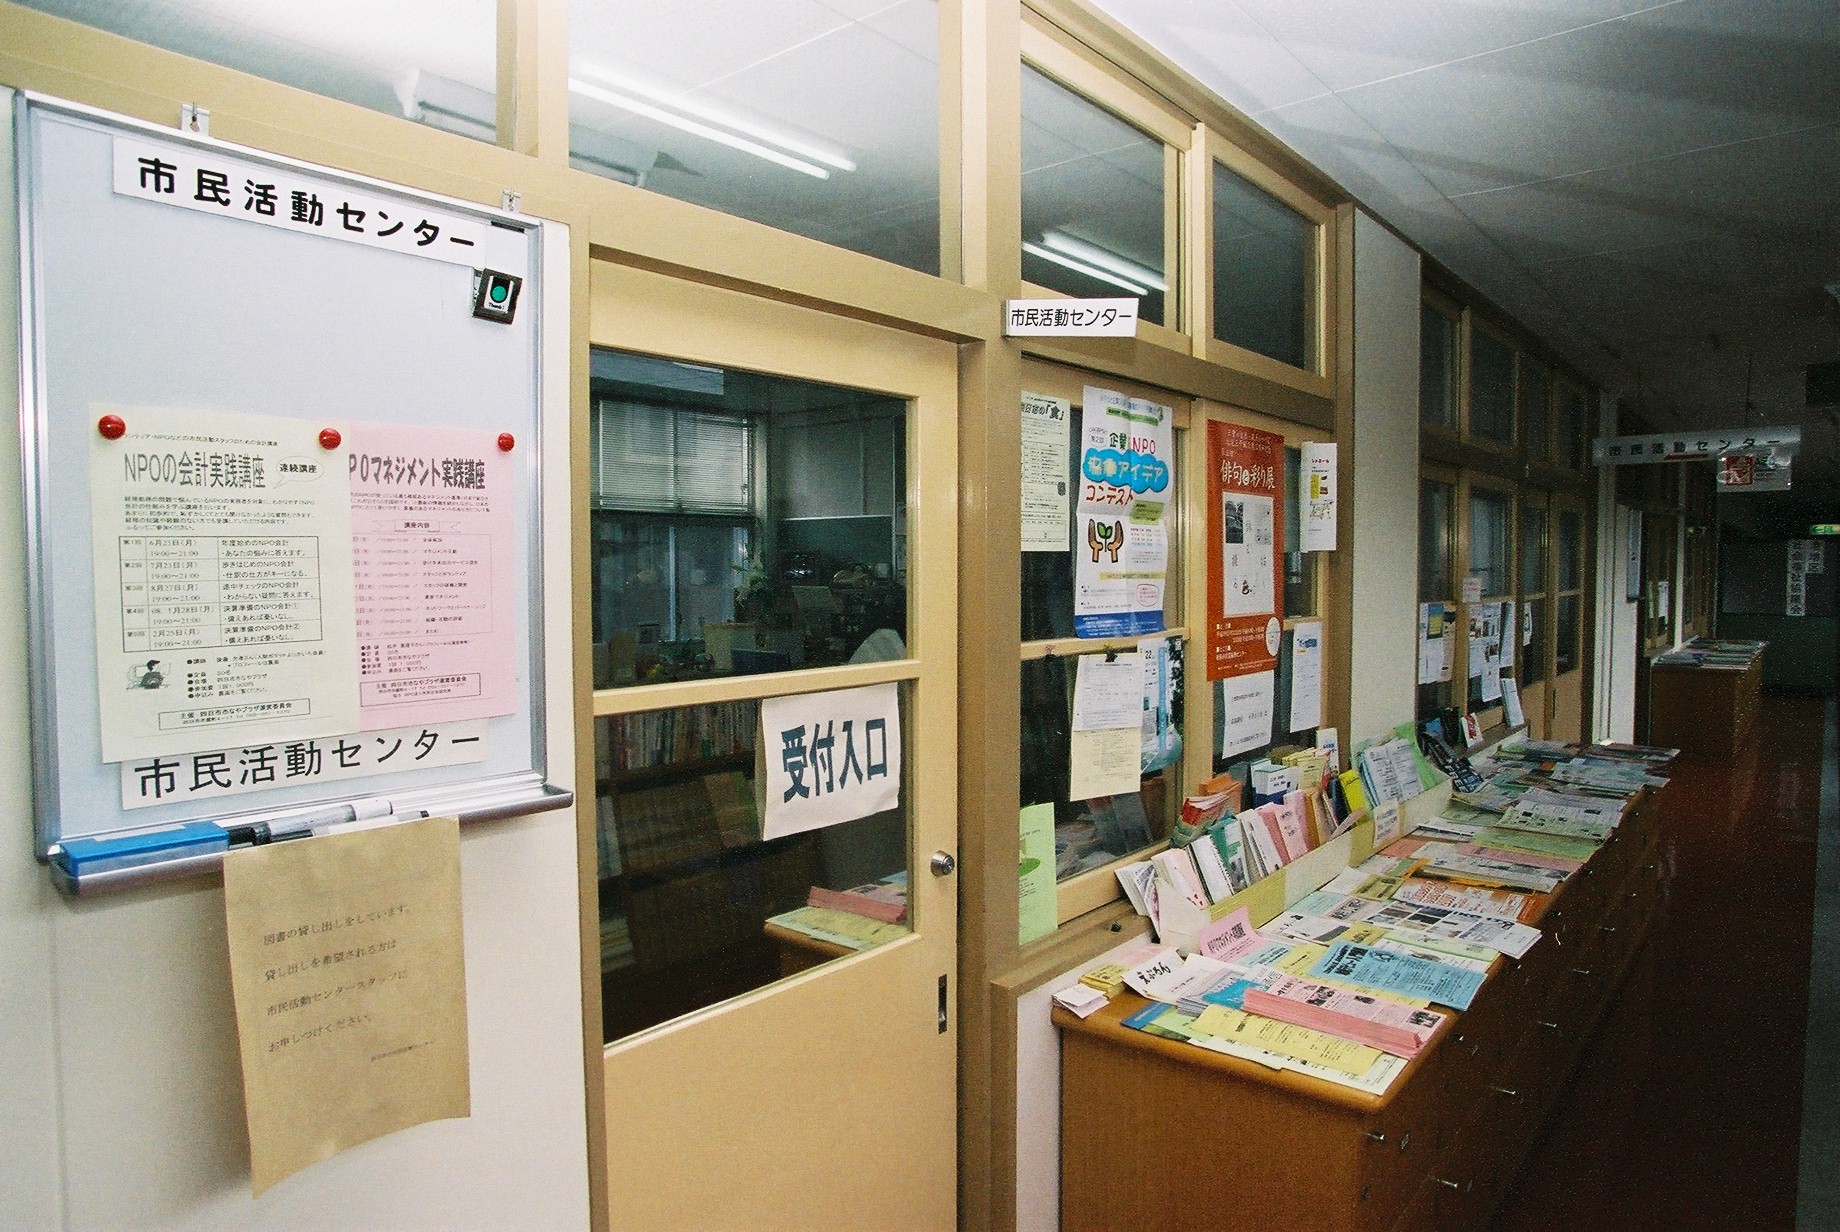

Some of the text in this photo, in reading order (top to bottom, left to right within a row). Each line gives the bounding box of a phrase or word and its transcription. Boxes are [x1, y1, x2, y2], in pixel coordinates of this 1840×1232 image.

[137, 157, 475, 247] 市民活動センター
[1011, 308, 1132, 327] 市民活動センター
[1608, 438, 1781, 457] 市民活動センター
[123, 450, 266, 489] NPOの会計実践講座
[279, 463, 318, 474] 連続講座
[1085, 484, 1134, 506] コンテスト
[221, 539, 289, 547] 年度始めのNPO会計
[221, 560, 294, 569] 歩きはじめのNPO会計
[222, 581, 299, 590] 途中チェックのNPO会計
[390, 676, 467, 688] 四日市市なやプラザ運営委員会
[200, 702, 292, 717] 四日市市なやプラザ運営委員会
[134, 729, 480, 799] 市民活動センター
[780, 717, 888, 804] 受付入口
[263, 904, 411, 946] 図書の貸し出しをしています。
[264, 938, 398, 983] 貸し出しを希望される方は
[266, 970, 408, 1017] 市民活動センタースタッフに
[269, 1014, 371, 1053] お申しつけください。
